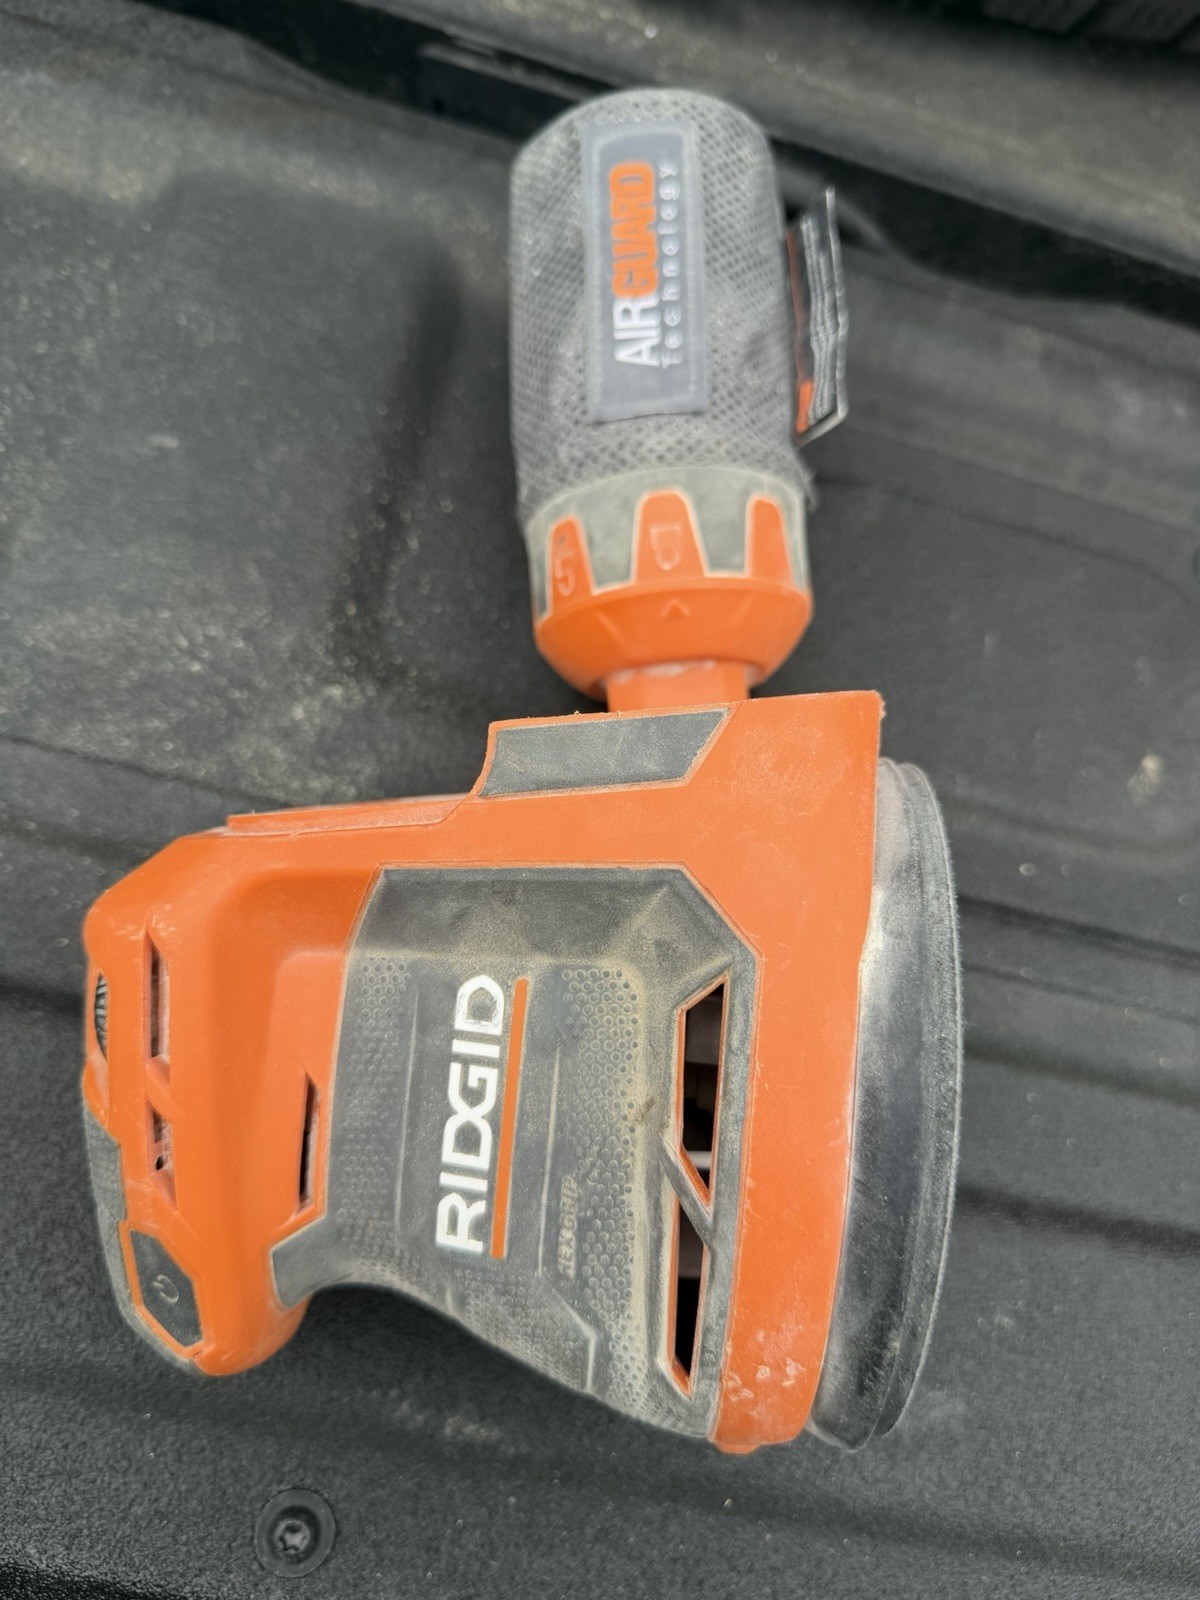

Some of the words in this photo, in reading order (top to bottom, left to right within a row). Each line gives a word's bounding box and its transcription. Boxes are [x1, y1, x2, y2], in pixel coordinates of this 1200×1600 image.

[609, 162, 659, 367] AIRGUARD
[660, 161, 683, 367] Technology
[436, 974, 505, 1254] RIDGID
